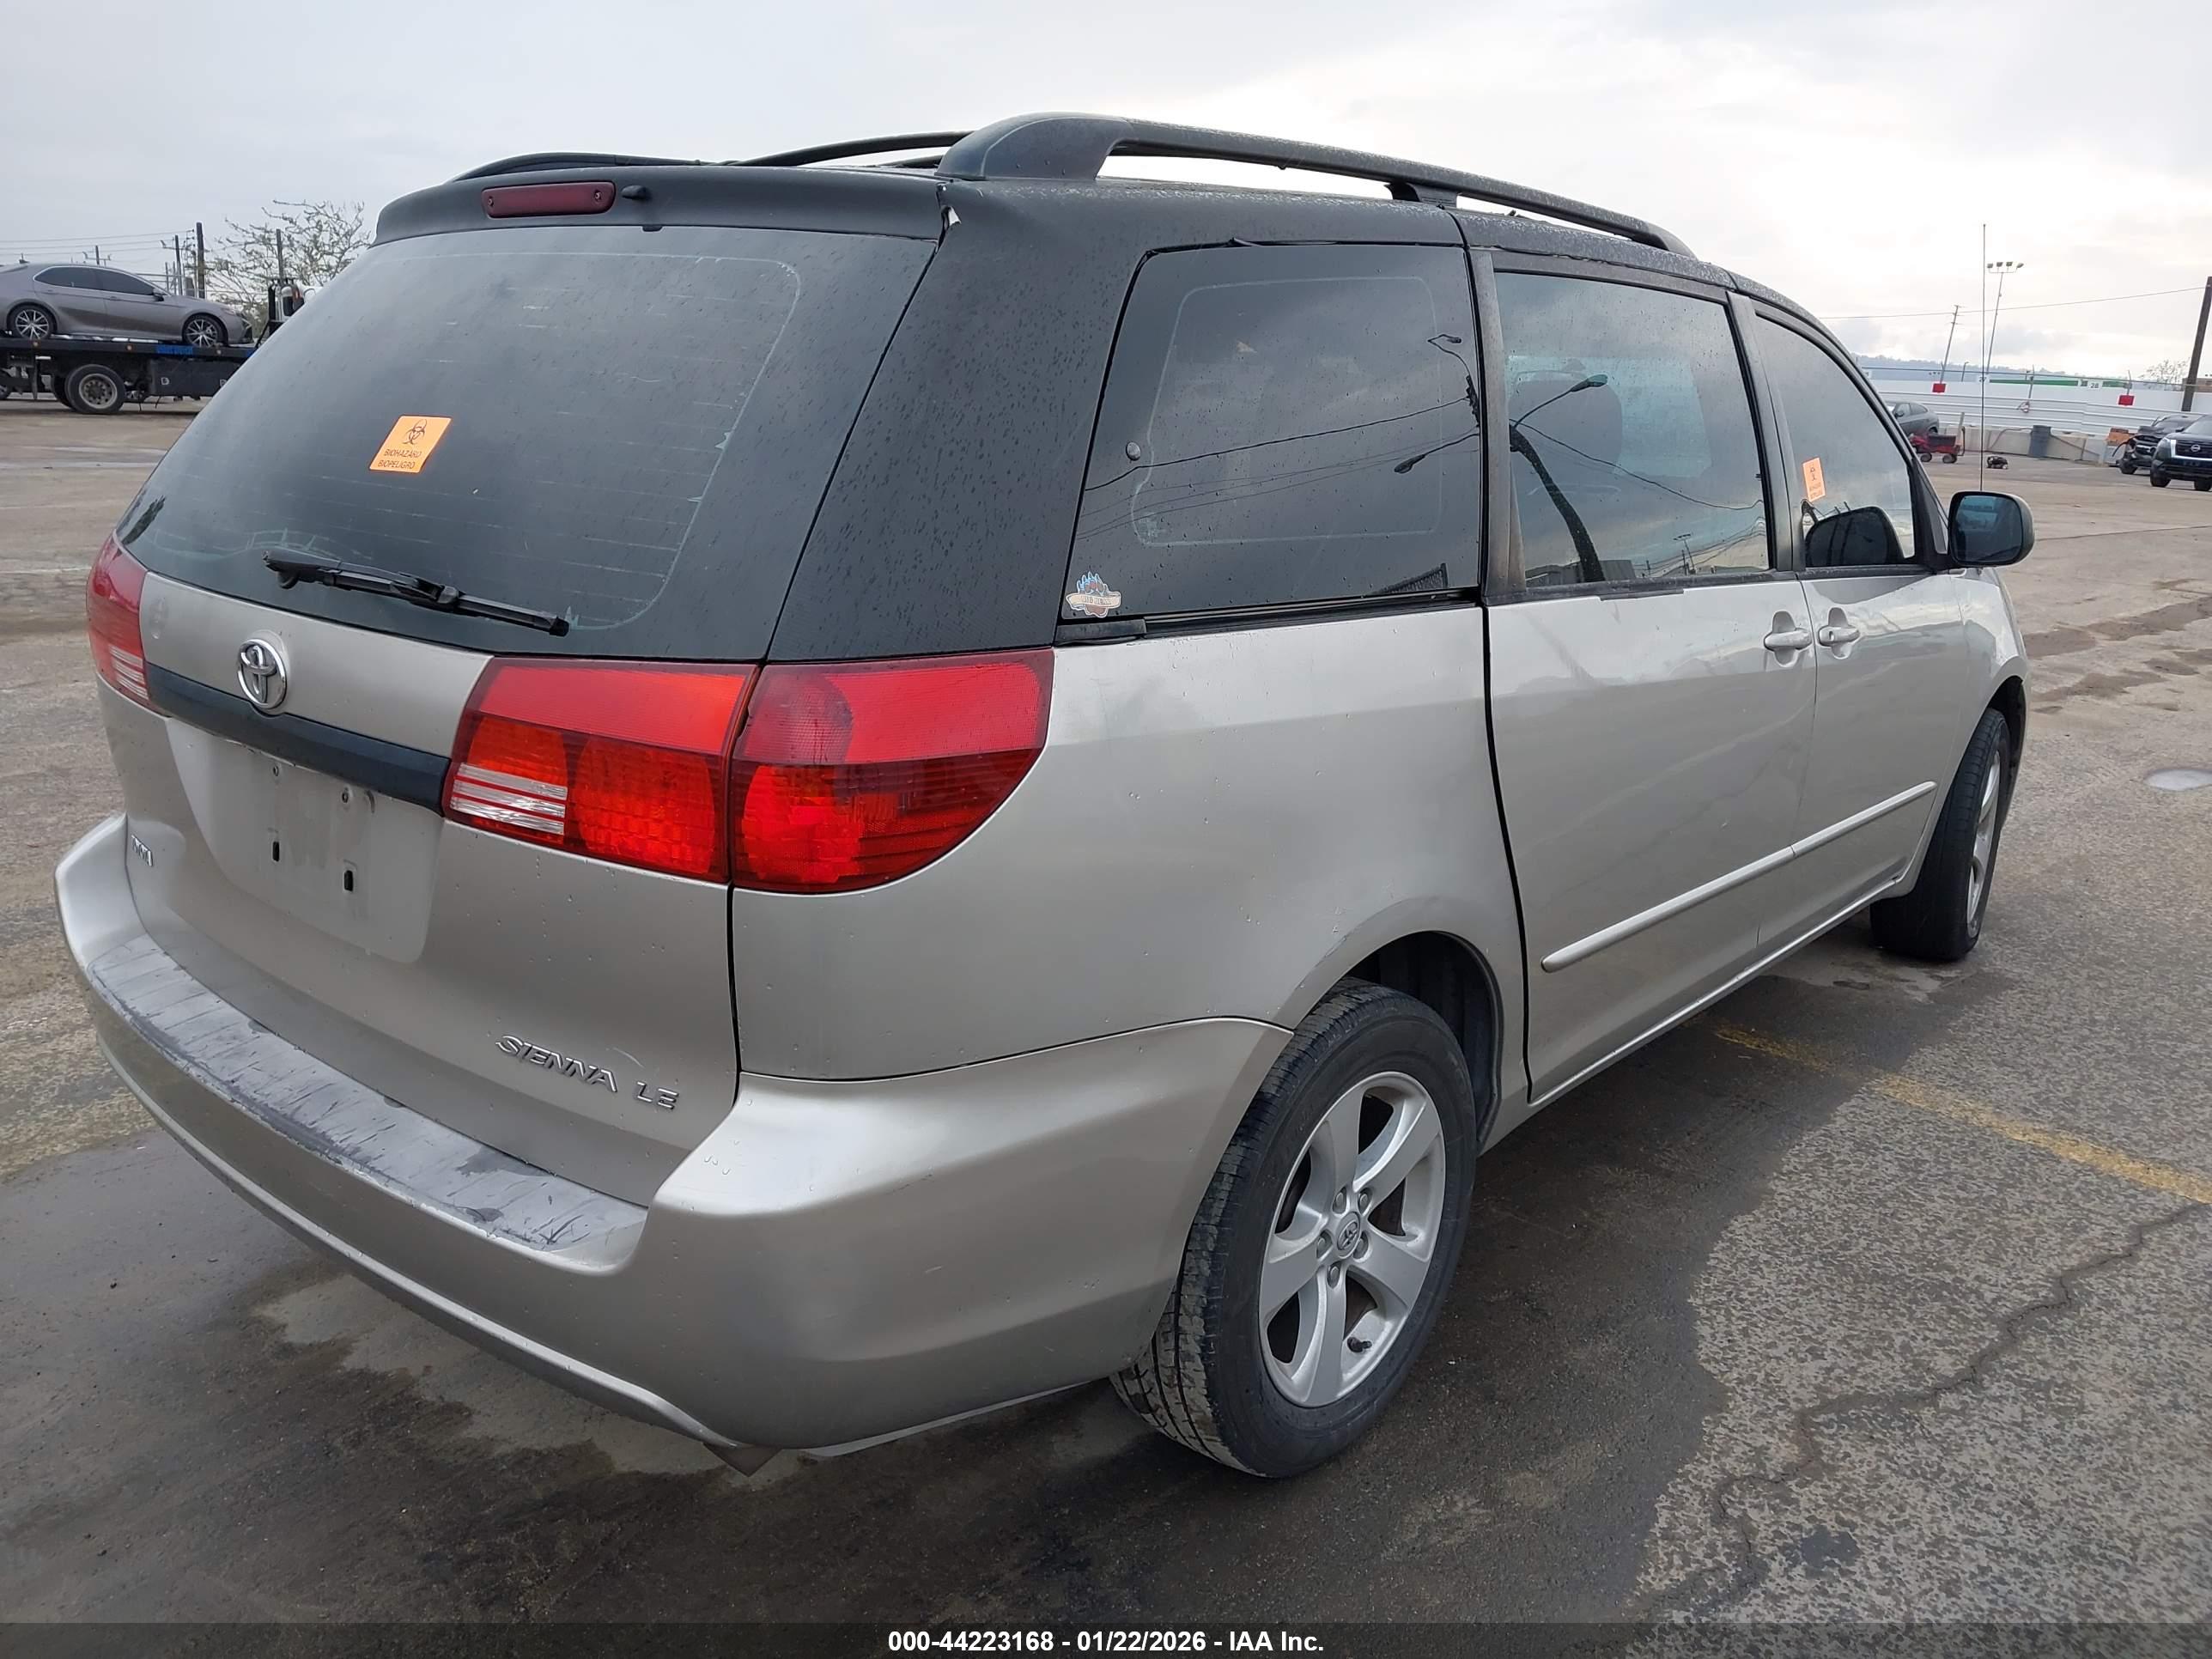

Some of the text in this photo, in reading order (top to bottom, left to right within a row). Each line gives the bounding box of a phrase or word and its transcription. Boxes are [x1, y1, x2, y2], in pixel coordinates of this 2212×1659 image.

[383, 448, 422, 459] BIOHAZARD
[377, 459, 416, 470] BIOPELIGRO
[495, 1034, 680, 1110] SIENNA LE
